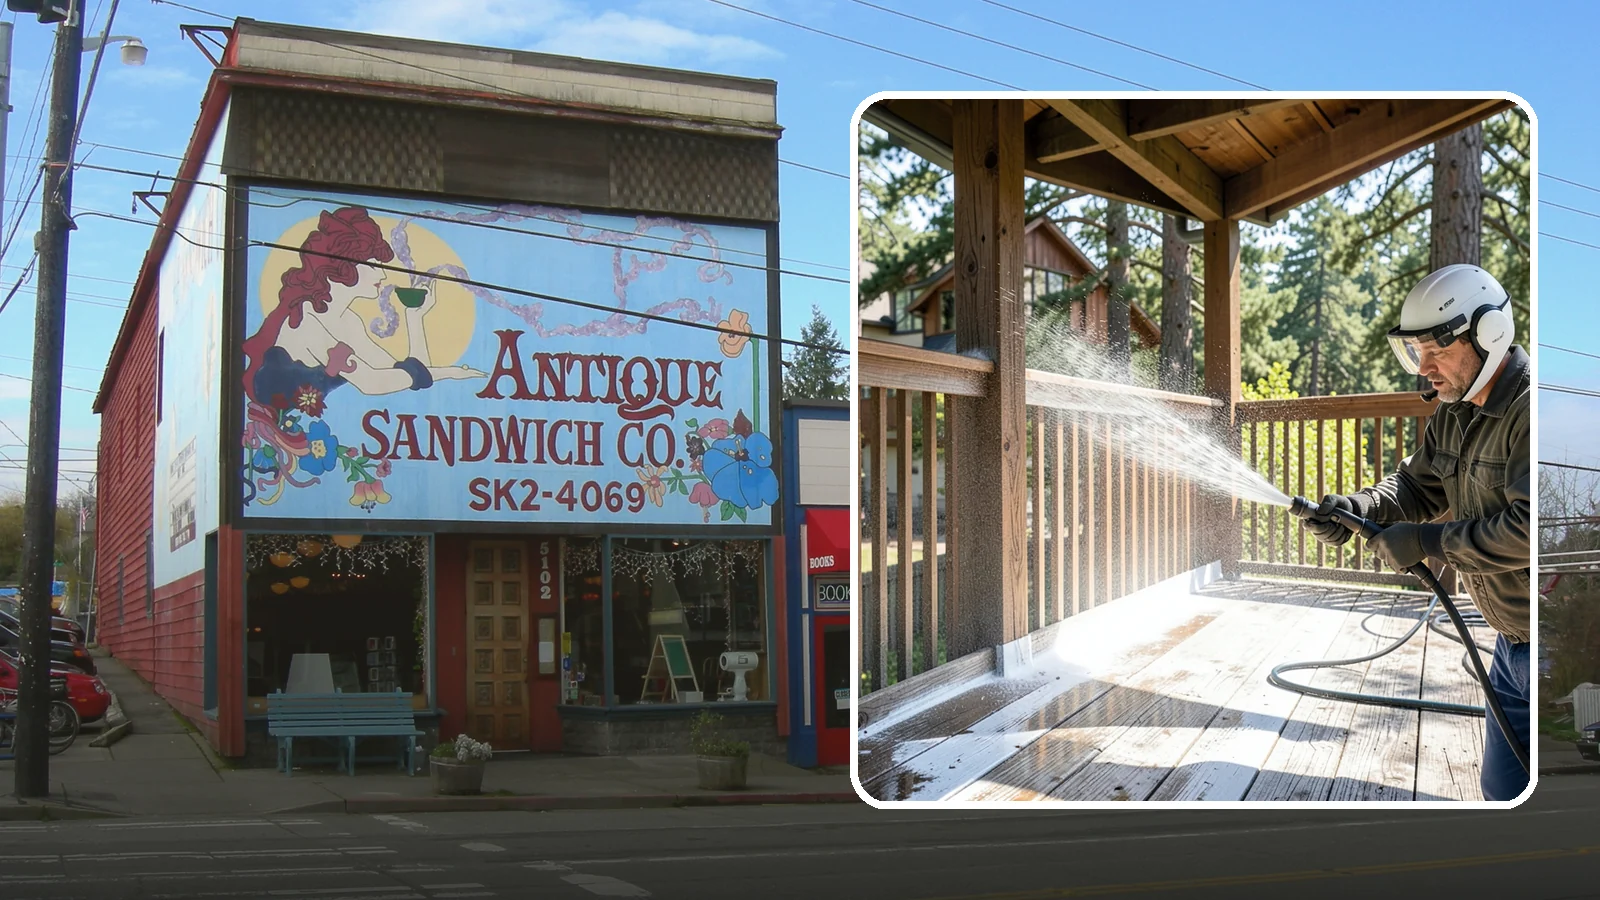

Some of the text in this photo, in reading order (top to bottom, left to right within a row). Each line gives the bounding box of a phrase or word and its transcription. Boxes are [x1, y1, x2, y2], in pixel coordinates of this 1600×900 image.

[476, 329, 724, 420] ANTIQUE
[361, 409, 685, 469] SANDWICH CO.
[468, 477, 646, 512] SK2-4069
[540, 542, 551, 600] 5102
[809, 555, 835, 569] BOOKS
